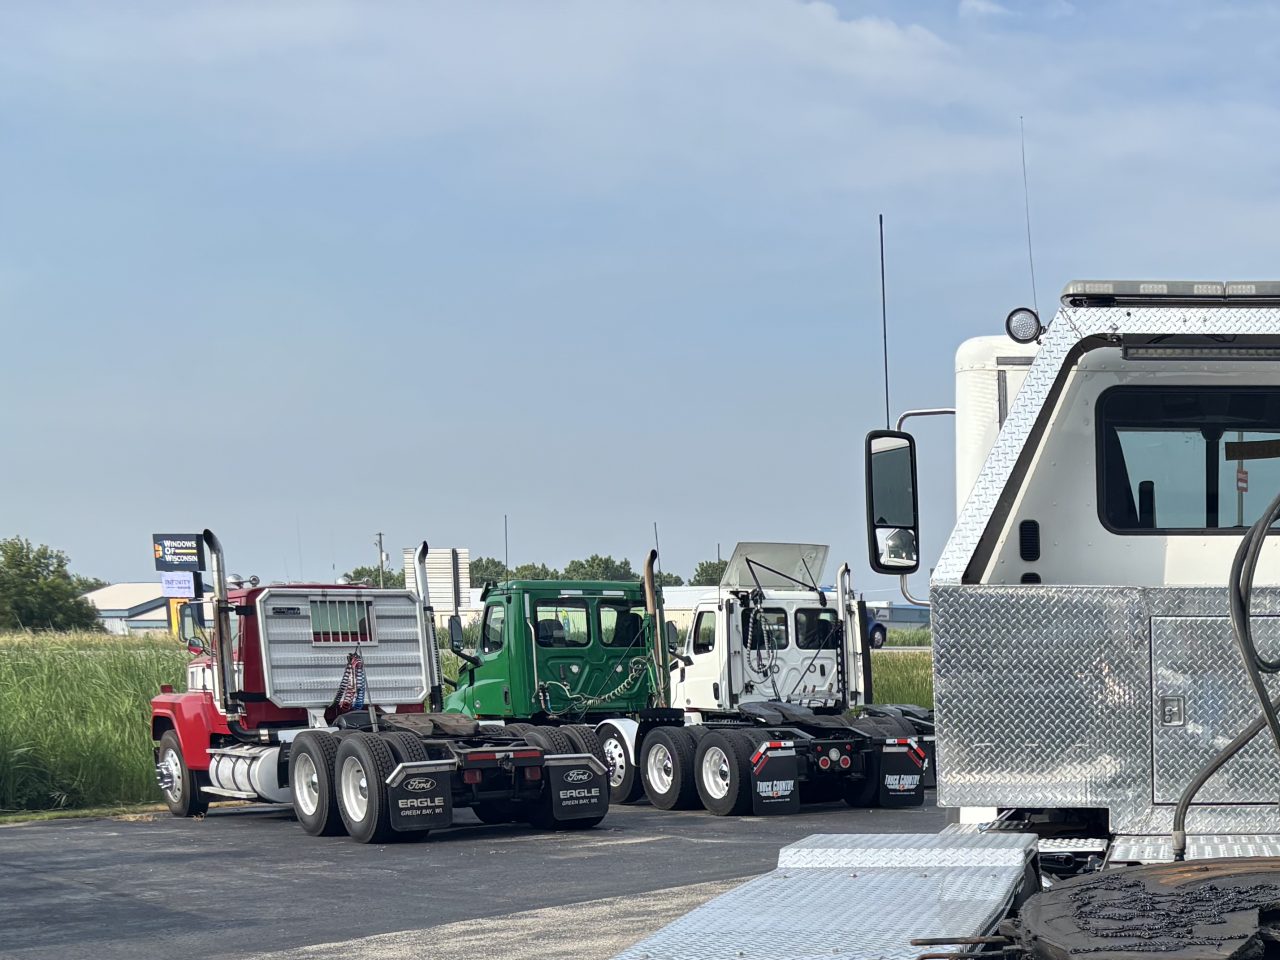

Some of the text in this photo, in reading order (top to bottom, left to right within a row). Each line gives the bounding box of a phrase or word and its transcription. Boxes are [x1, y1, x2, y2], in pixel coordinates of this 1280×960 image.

[164, 540, 197, 548] WINDOWS
[165, 547, 175, 555] OF
[165, 554, 198, 562] WISCONSIN
[567, 771, 589, 781] Ford
[408, 779, 432, 790] Ford
[559, 787, 600, 799] EAGLE
[398, 797, 445, 808] EAGLE
